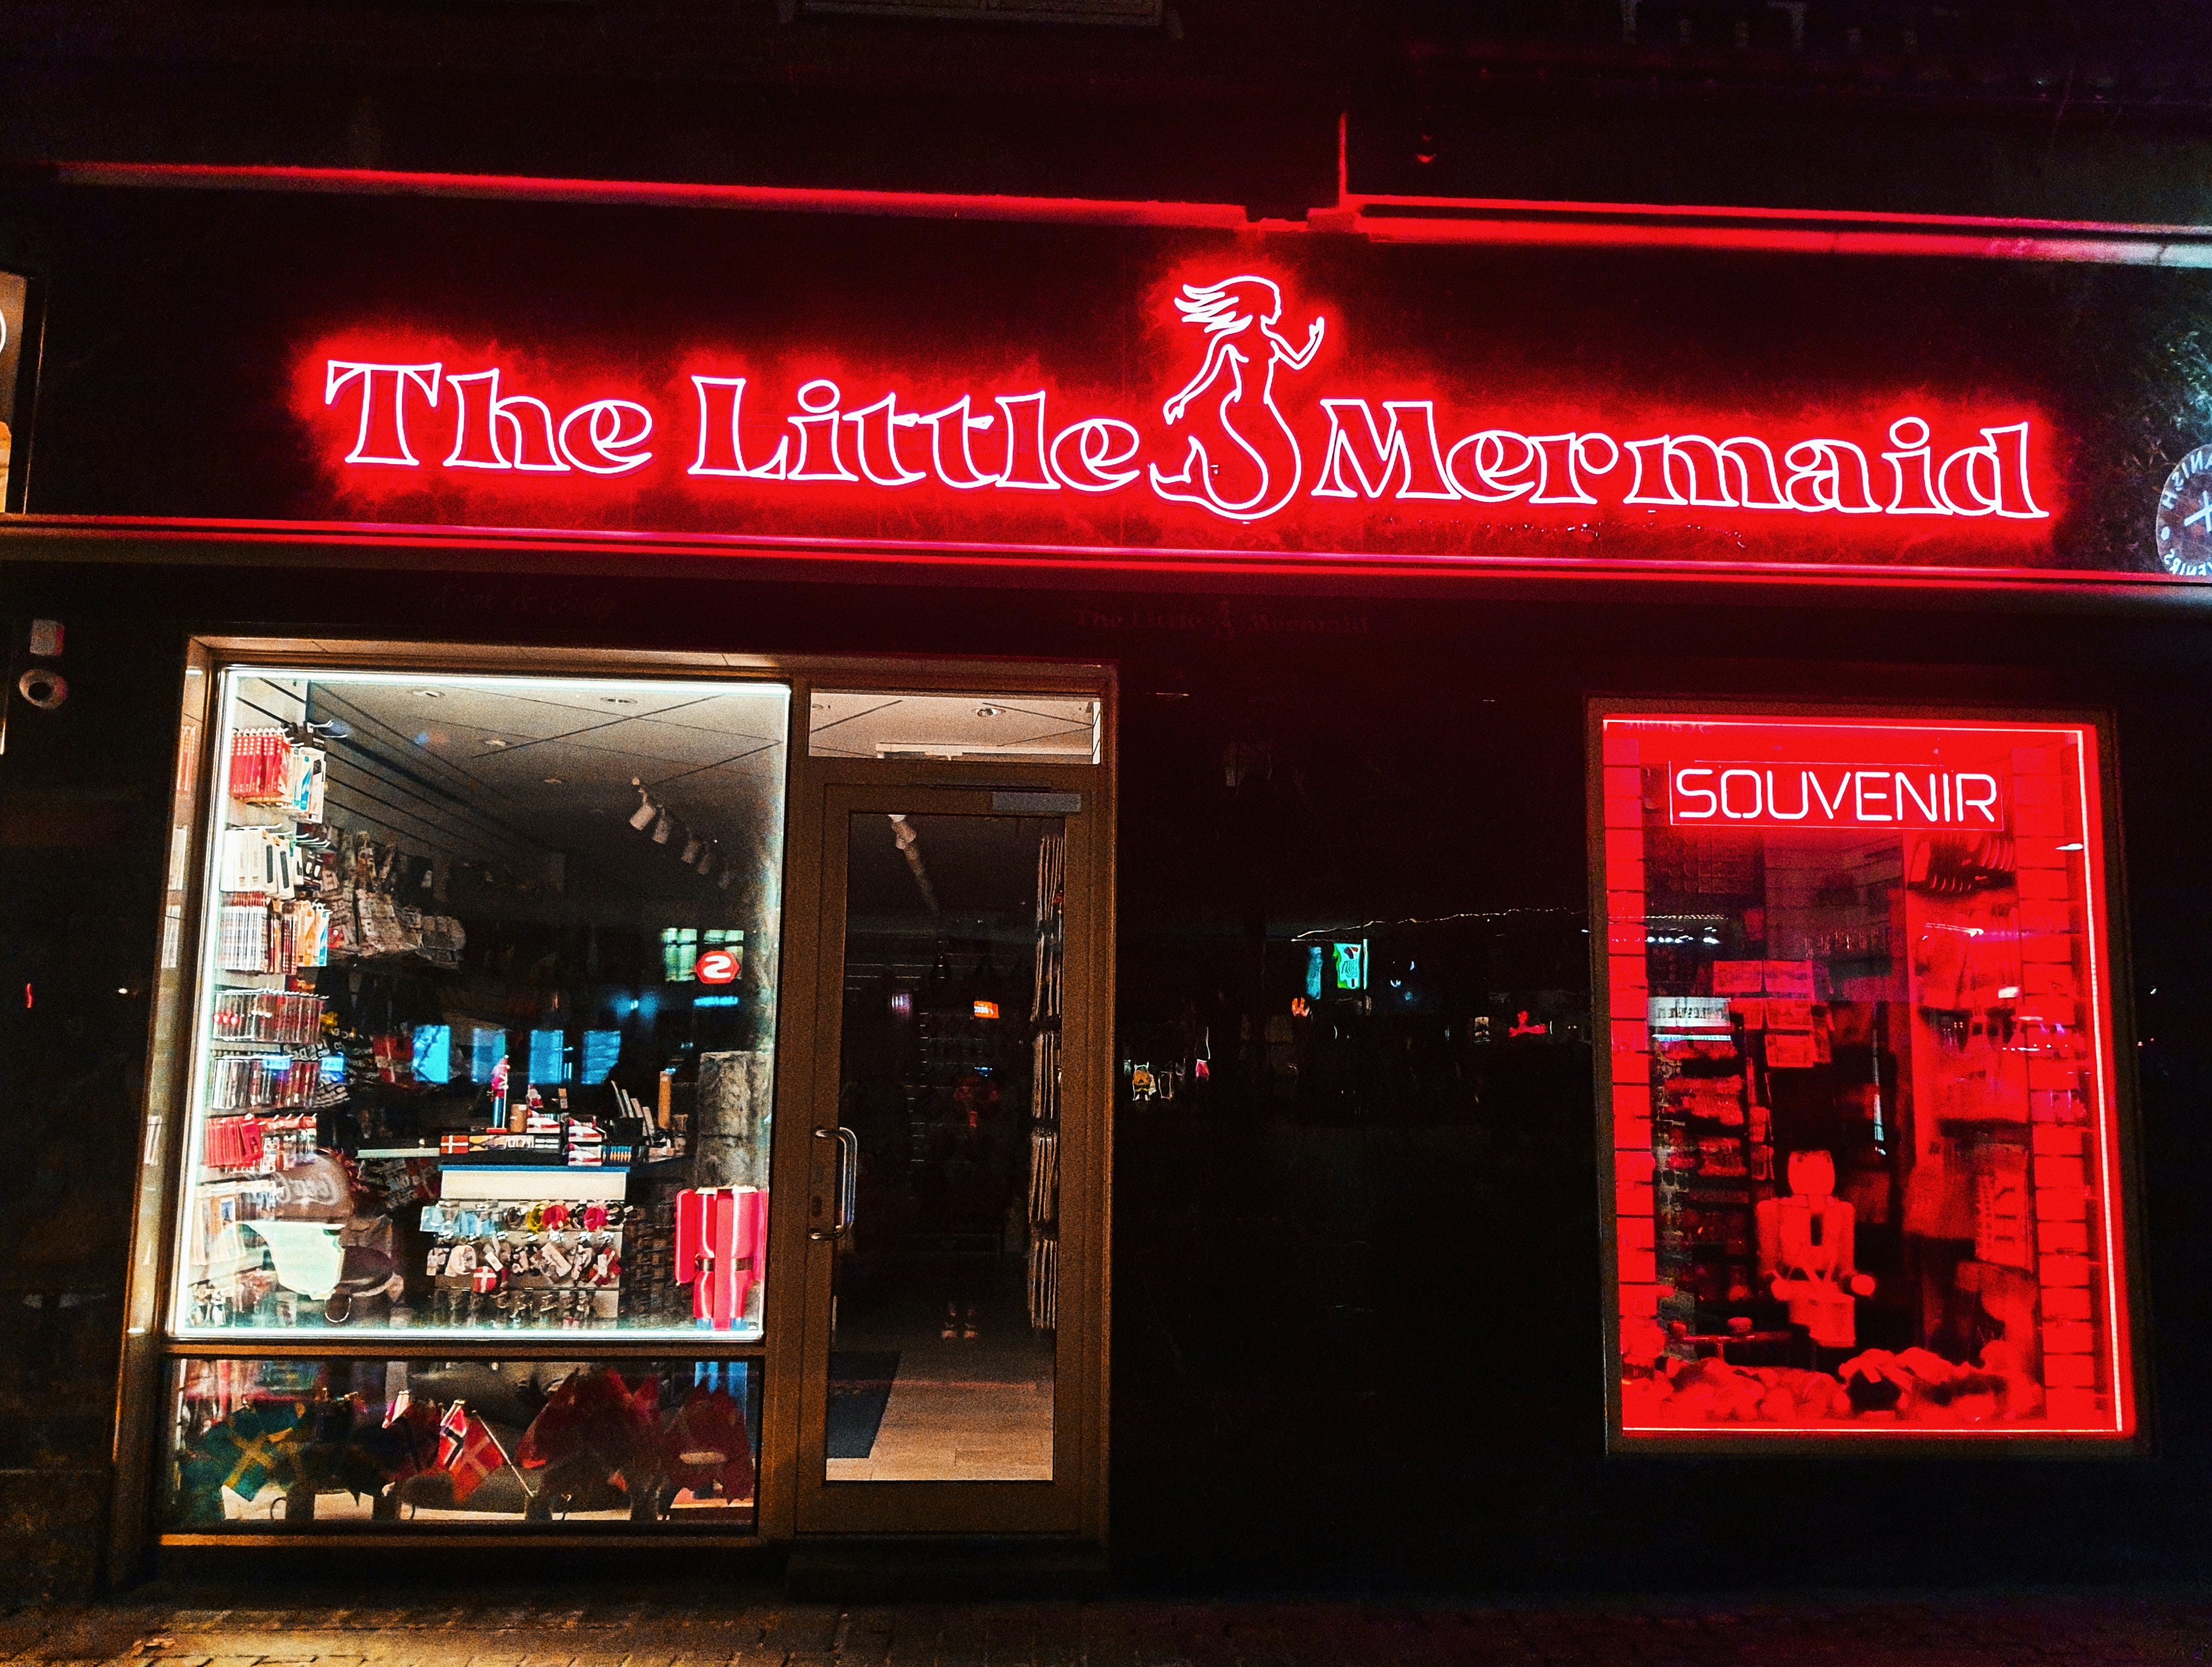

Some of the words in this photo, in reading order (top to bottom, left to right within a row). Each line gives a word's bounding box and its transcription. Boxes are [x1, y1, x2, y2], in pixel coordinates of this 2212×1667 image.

[326, 359, 653, 474] The
[687, 375, 1141, 492] Little
[1311, 398, 2050, 519] Mermaid
[1676, 768, 1997, 822] SOUVENIR
